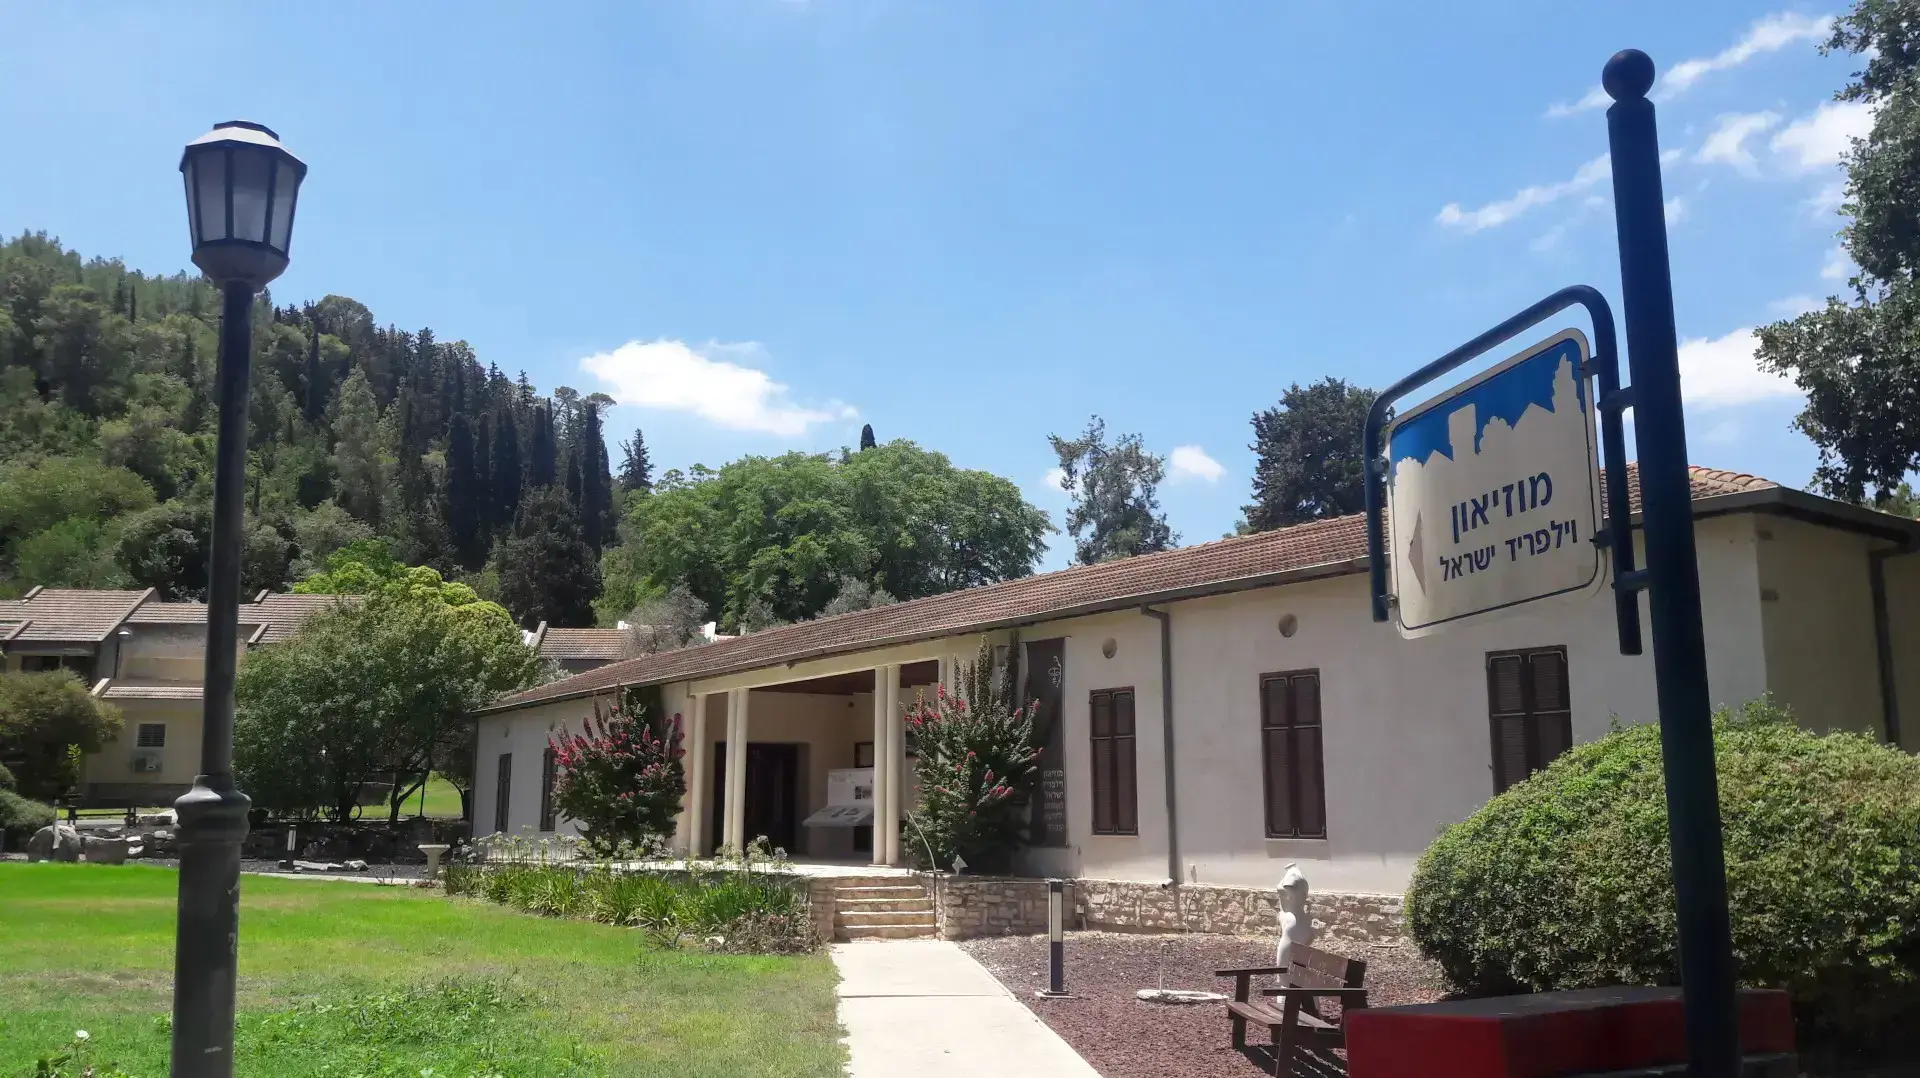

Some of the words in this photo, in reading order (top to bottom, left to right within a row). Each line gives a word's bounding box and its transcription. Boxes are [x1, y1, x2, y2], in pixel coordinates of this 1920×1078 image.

[1452, 471, 1553, 544] מוזיאון
[1505, 519, 1578, 562] וילפריד
[1439, 545, 1496, 582] ישראל
